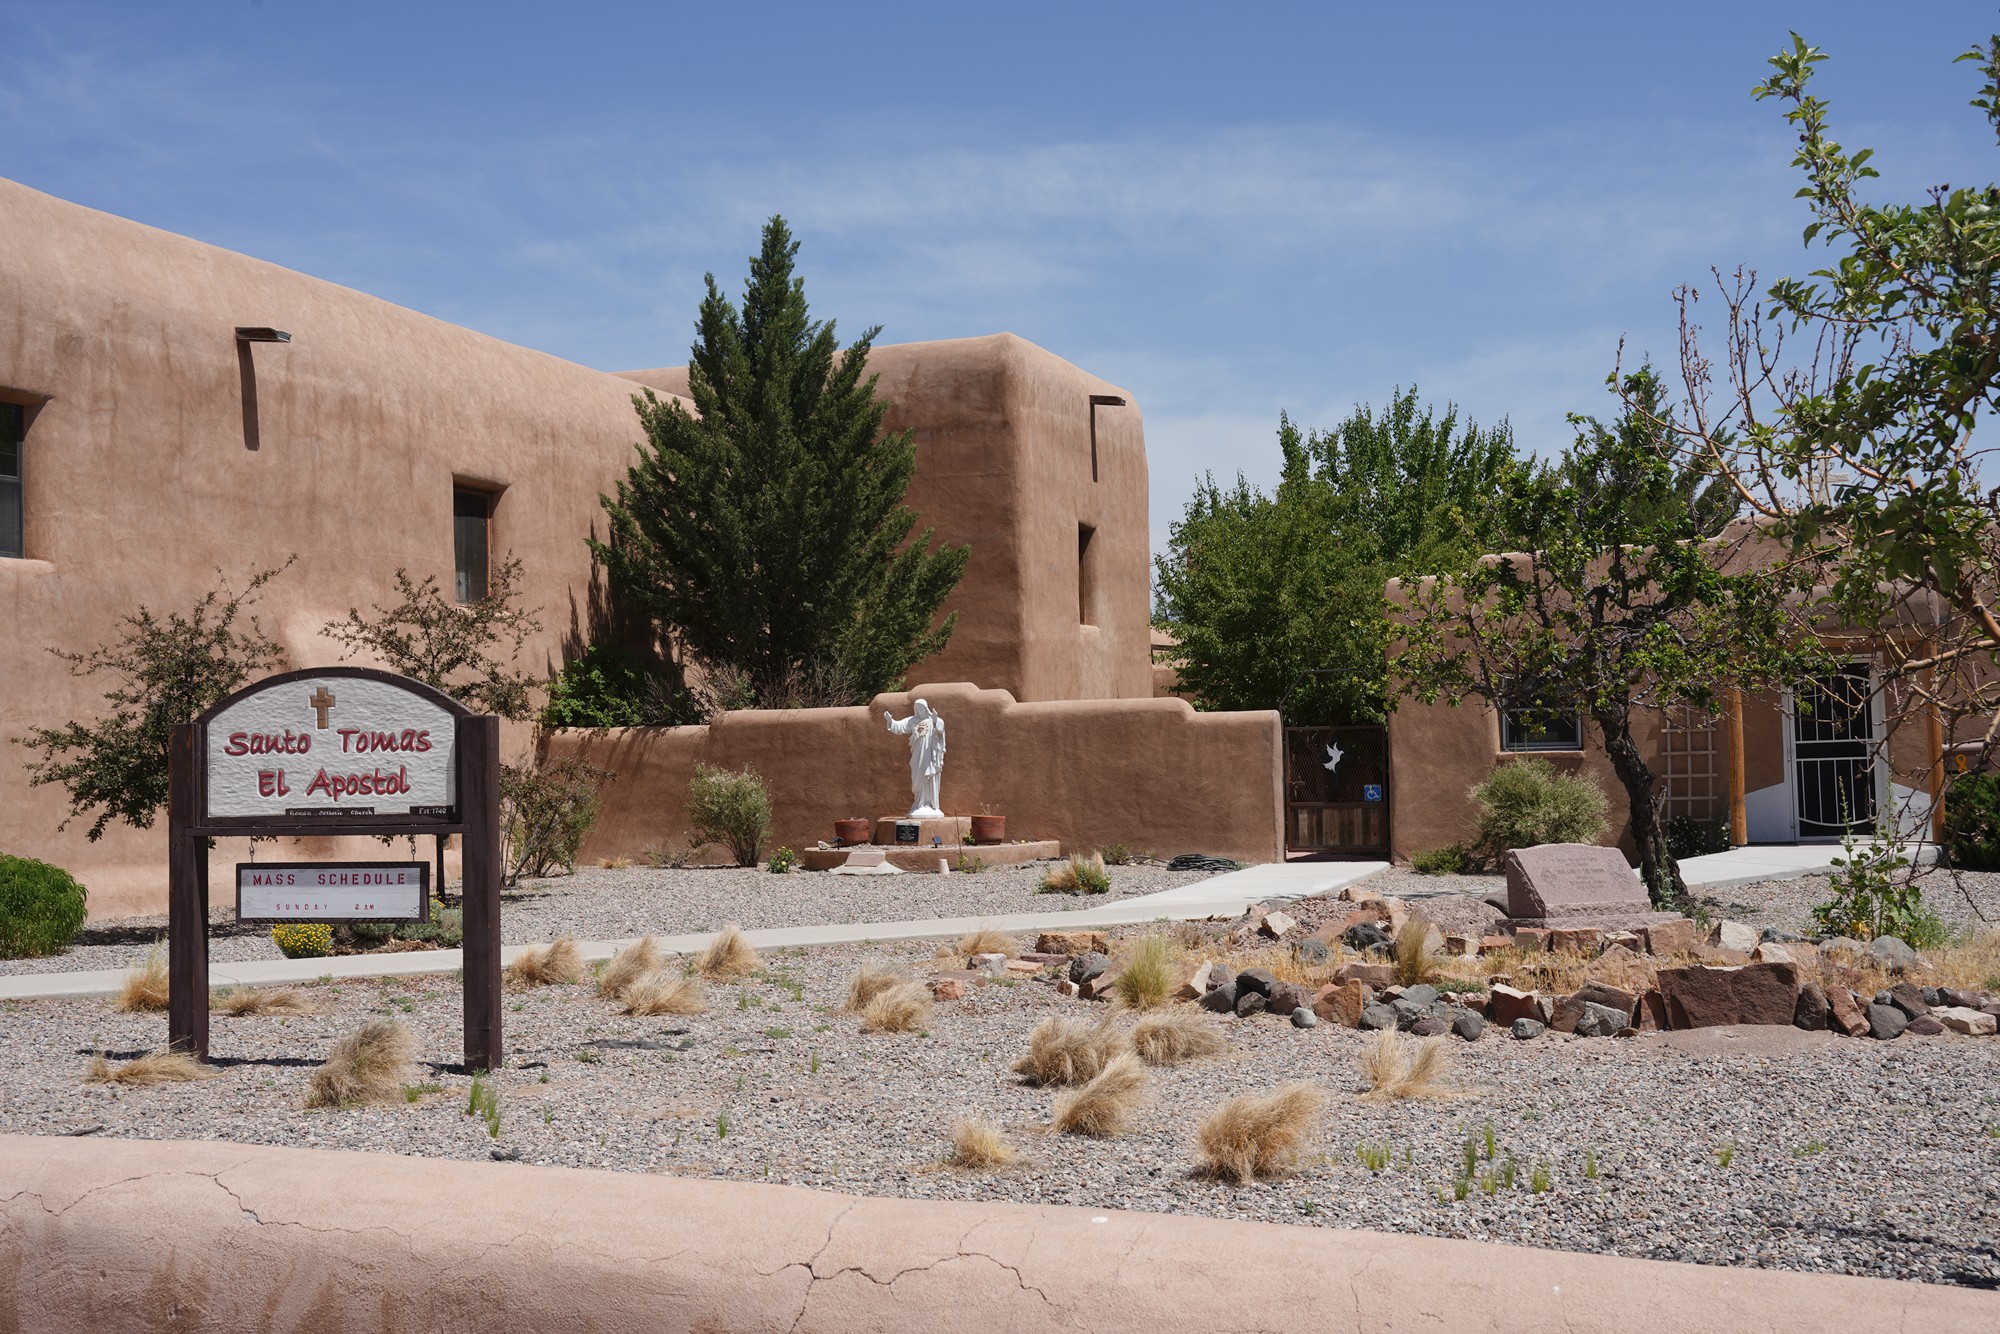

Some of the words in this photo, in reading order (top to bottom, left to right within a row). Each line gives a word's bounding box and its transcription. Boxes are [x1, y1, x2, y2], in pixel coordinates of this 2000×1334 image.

[223, 728, 311, 756] Santo
[336, 727, 432, 754] Tomas
[257, 769, 290, 798] El
[305, 764, 411, 802] Apostol
[350, 808, 373, 816] Church
[253, 873, 296, 886] MASS
[317, 872, 406, 886] SCHEDULE
[276, 903, 328, 911] SUNDAY
